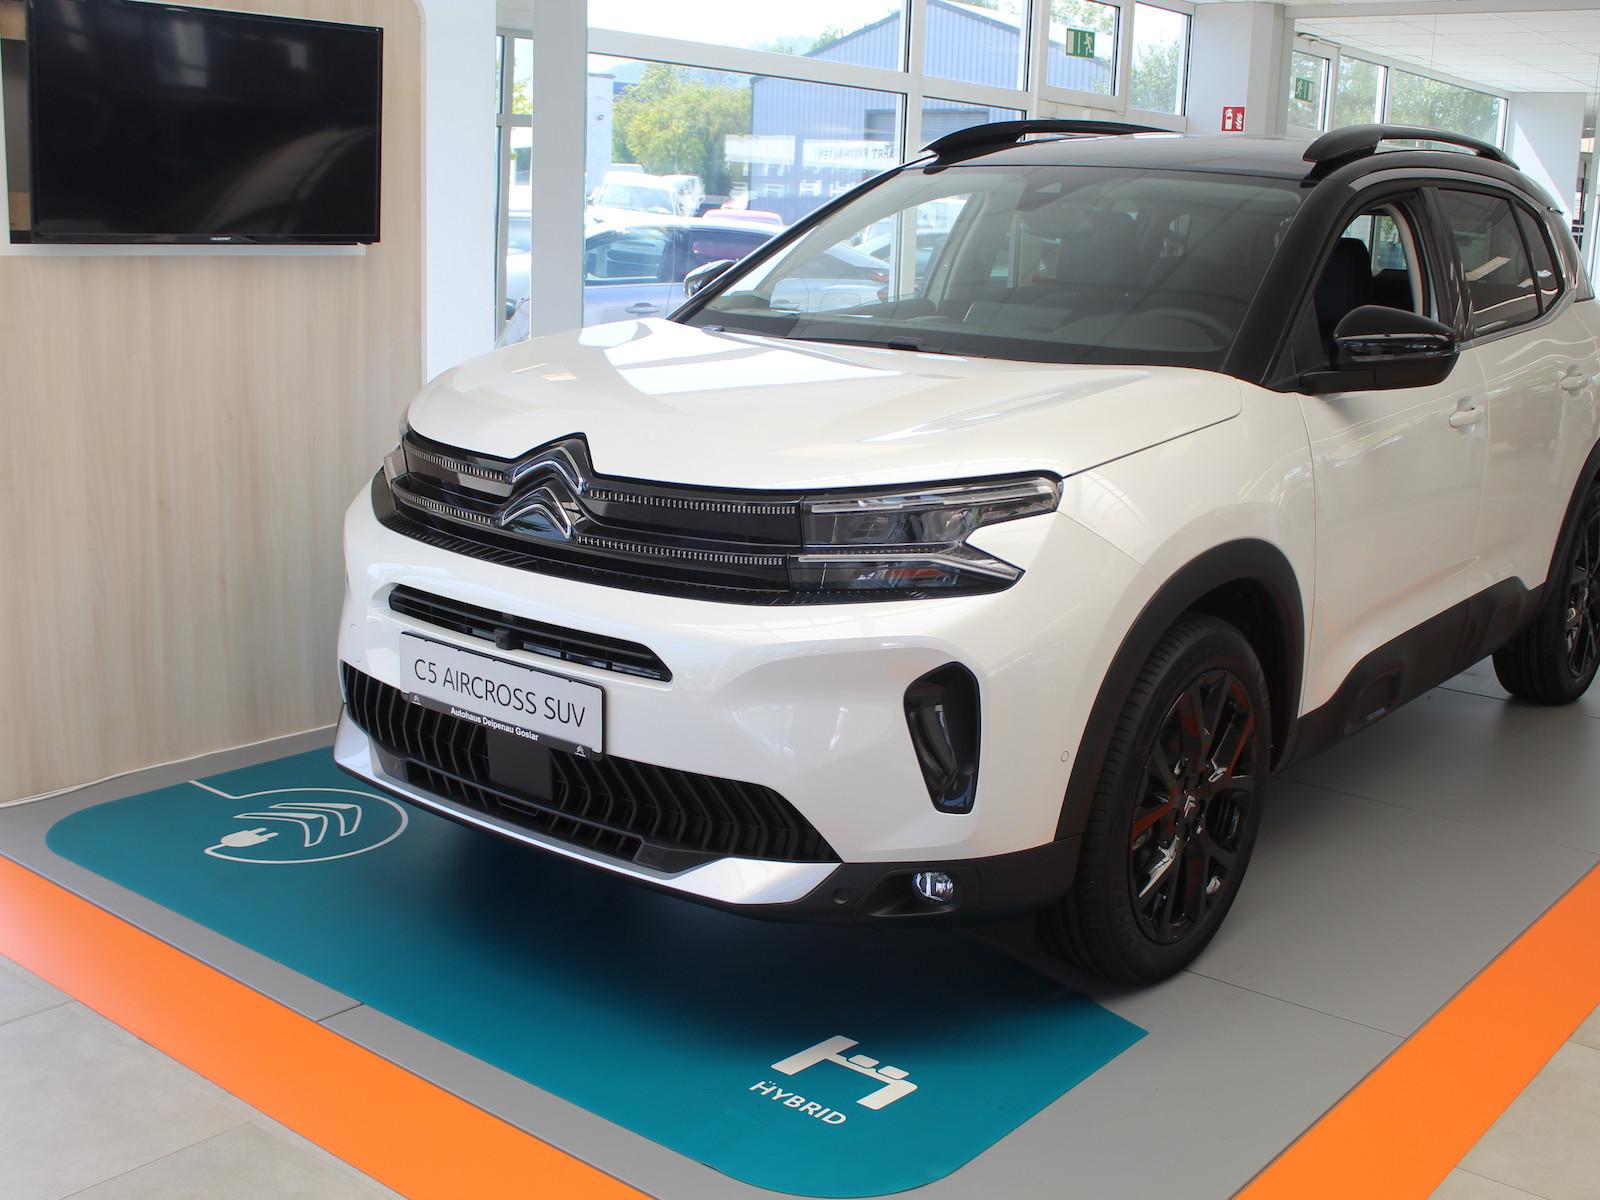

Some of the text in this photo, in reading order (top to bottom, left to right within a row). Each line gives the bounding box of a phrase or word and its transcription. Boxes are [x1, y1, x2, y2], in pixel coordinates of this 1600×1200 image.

[413, 658, 586, 728] C5 AIRCROSS SUV
[450, 706, 540, 741] Autohaus Deipenau Goslar
